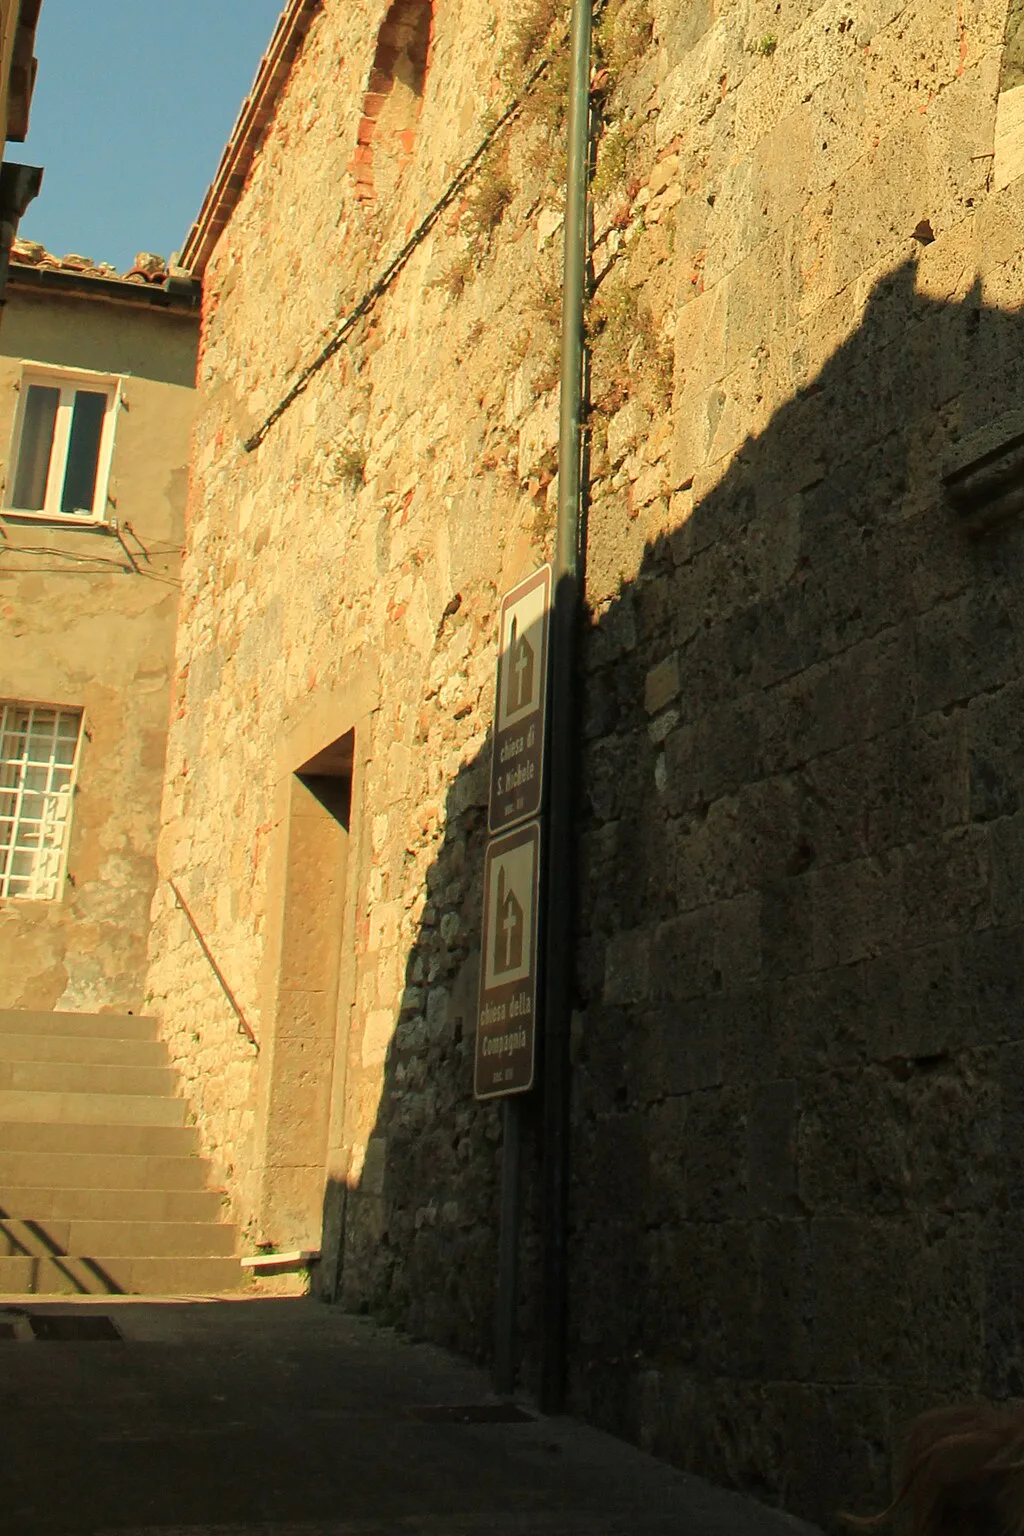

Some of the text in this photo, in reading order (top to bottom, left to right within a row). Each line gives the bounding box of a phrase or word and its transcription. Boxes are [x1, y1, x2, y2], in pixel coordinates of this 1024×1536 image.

[500, 724, 535, 762] chiesa di
[497, 760, 534, 796] S. Michele
[480, 991, 531, 1026] chiesa della
[482, 1025, 526, 1058] Compagnia
